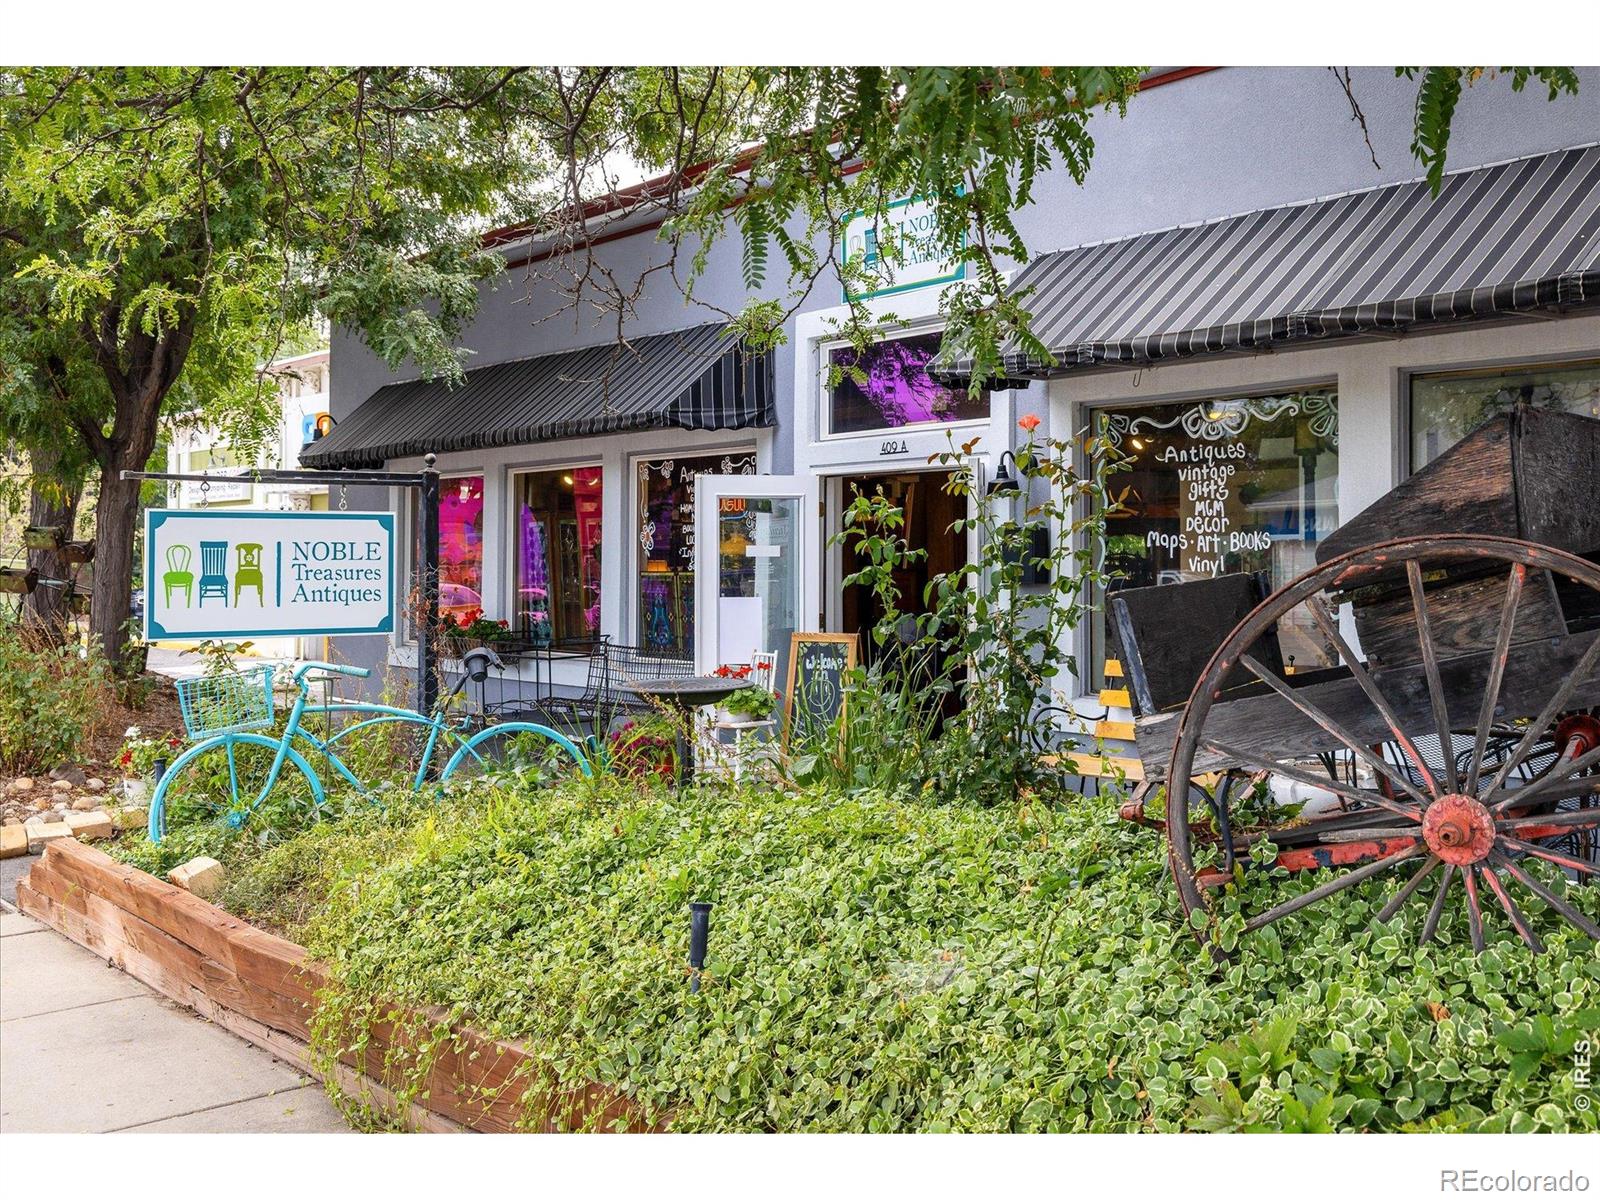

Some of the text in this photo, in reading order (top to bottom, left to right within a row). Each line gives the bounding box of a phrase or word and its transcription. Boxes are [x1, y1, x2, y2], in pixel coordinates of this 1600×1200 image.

[909, 213, 938, 232] NOB
[909, 247, 953, 266] Antique
[881, 440, 908, 453] 409 A
[1155, 443, 1246, 467] Antiques
[1188, 480, 1229, 500] gifts
[1194, 499, 1225, 517] MCM
[292, 541, 382, 561] NOBLE
[1147, 531, 1271, 559] Maps Art BOOKS
[291, 563, 382, 581] Treasures
[291, 583, 382, 606] Antiques
